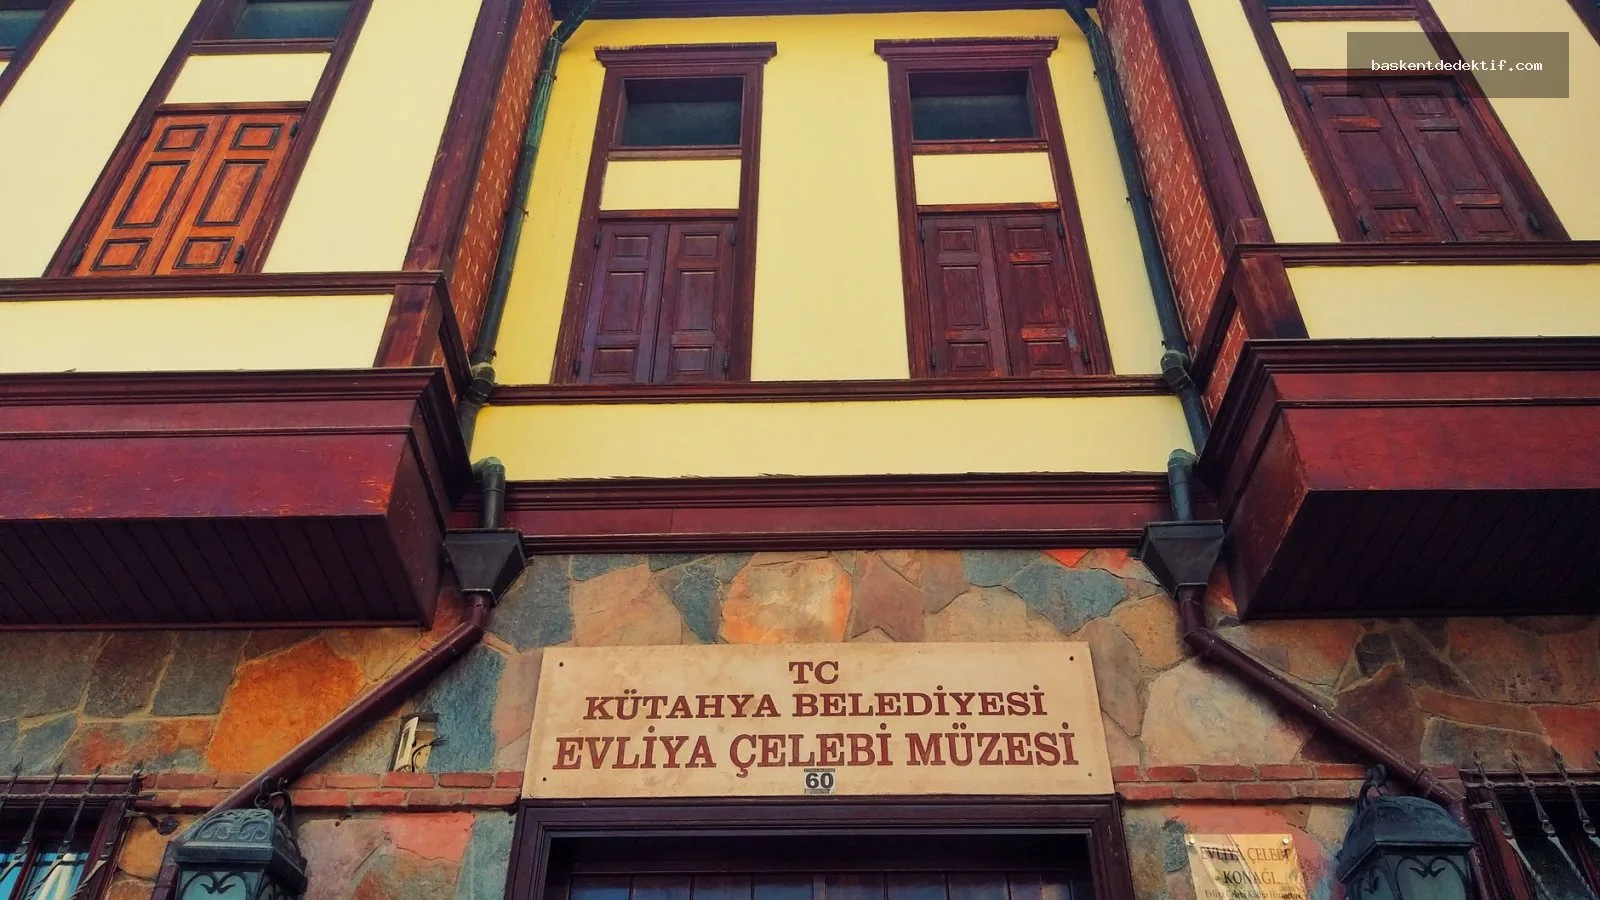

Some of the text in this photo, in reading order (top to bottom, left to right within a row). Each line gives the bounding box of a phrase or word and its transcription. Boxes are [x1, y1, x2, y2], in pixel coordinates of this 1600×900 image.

[788, 660, 839, 685] TC
[582, 684, 1048, 721] KÜTAHYA BELEDİYESİ
[552, 721, 1080, 778] EVLİYA ÇELEBİ MÜZESİ
[805, 772, 834, 789] 60
